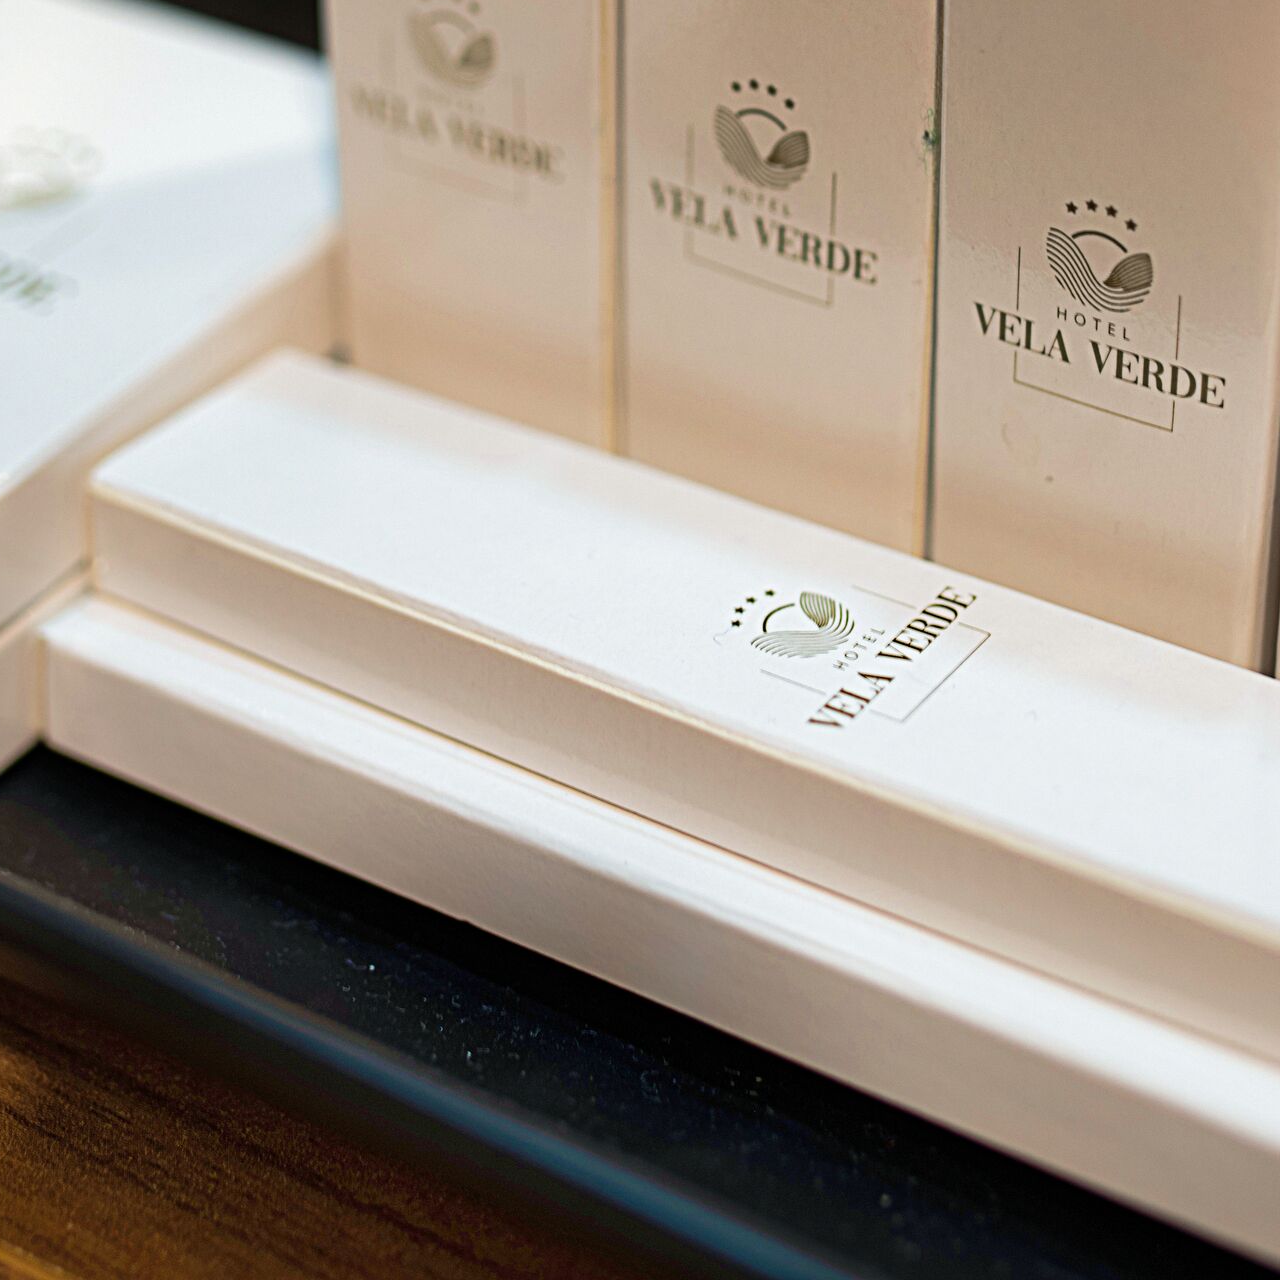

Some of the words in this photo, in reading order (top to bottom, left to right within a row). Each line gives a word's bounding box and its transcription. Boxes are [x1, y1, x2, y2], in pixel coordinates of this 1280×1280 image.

[650, 177, 738, 240] VELA
[754, 215, 878, 285] VERDE
[974, 301, 1072, 364] VELA
[1089, 339, 1226, 409] VERDE
[1056, 306, 1131, 341] HOTEL
[807, 671, 895, 728] VELA
[877, 586, 977, 662] VERDE
[833, 627, 886, 669] HOTEL
